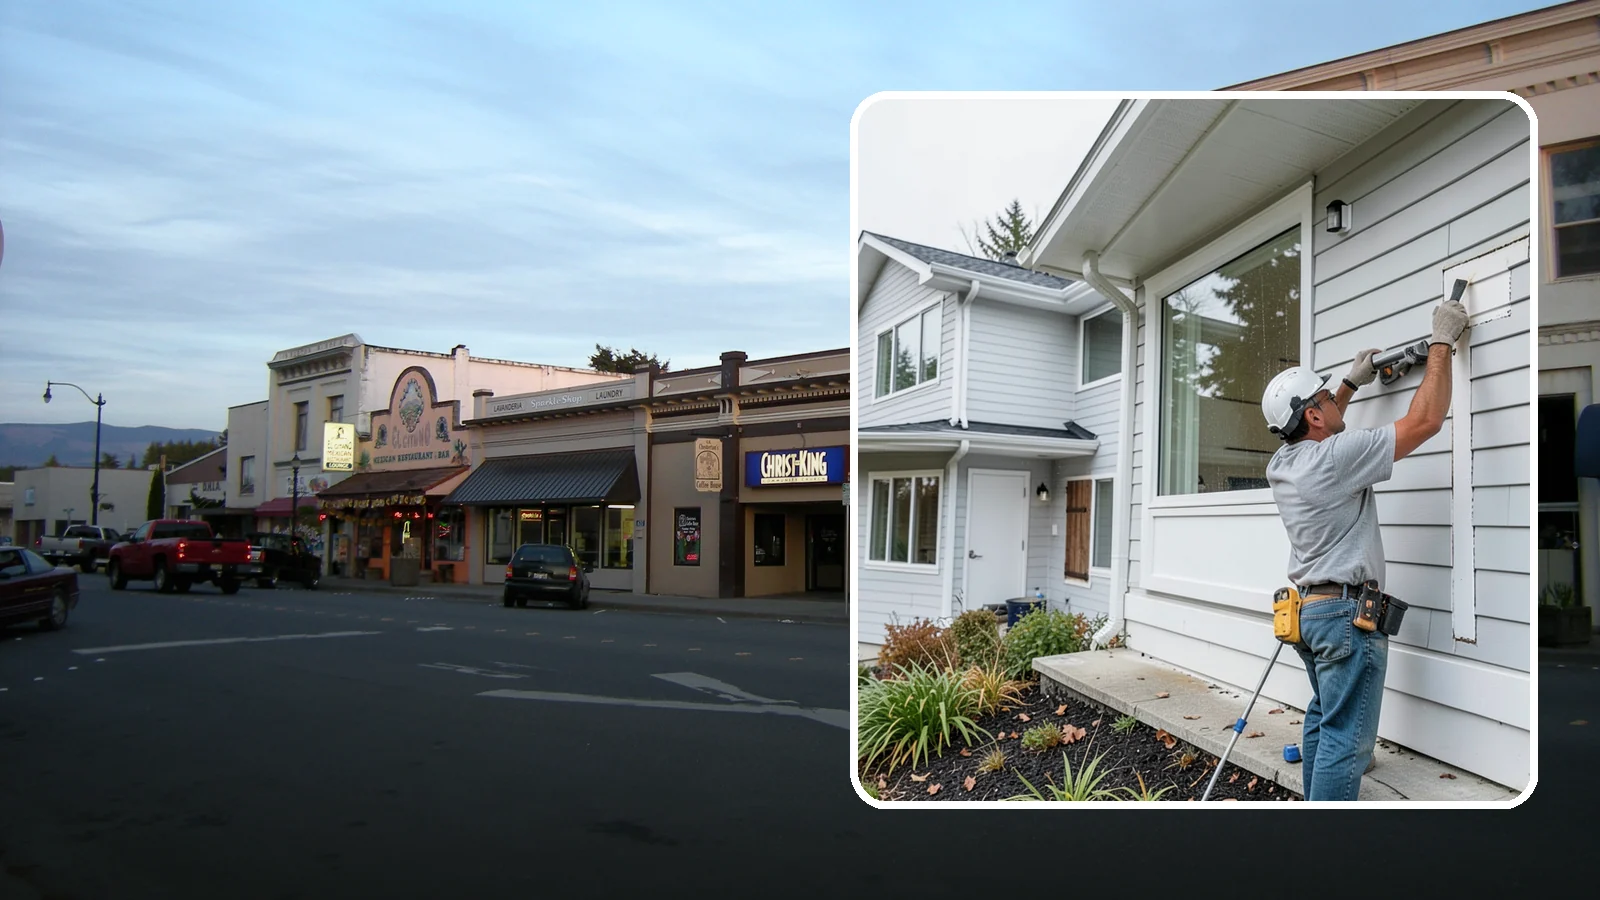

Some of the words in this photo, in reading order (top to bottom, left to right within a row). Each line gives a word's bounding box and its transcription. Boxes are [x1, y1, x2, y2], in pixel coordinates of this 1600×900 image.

[493, 402, 523, 413] LAVANDERIA
[531, 396, 561, 408] Sparkle
[562, 393, 583, 404] Shop
[595, 389, 624, 400] LAUNDRY
[397, 451, 434, 462] RESTAURANT
[438, 450, 450, 459] BAR
